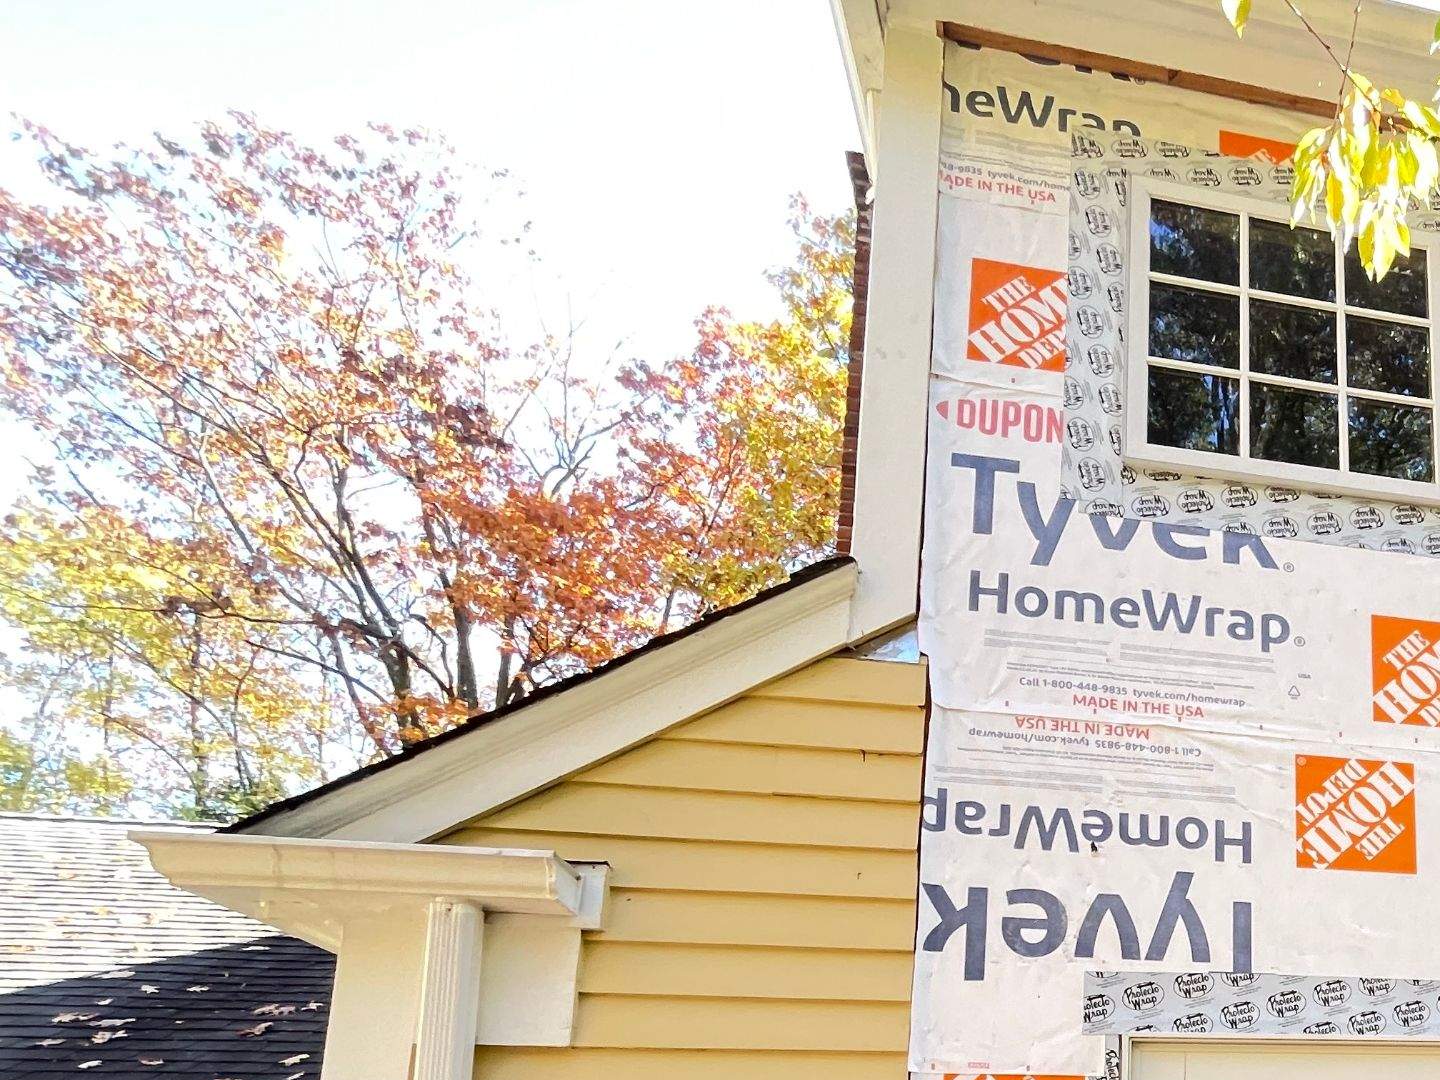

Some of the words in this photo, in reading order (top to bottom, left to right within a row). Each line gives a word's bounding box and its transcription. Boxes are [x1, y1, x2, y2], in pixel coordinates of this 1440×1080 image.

[977, 179, 993, 191] IN
[996, 182, 1024, 196] THE
[1028, 189, 1056, 202] USA
[968, 278, 1068, 363] HOM
[951, 452, 1279, 570] Tyvek
[968, 570, 1290, 652] HomeWrap
[1382, 629, 1431, 671] THE
[1019, 677, 1040, 688] Call
[1042, 679, 1128, 696] 1-800-448-9835
[1133, 687, 1246, 708] tyvek.com/homewrap
[1073, 694, 1118, 712] MADE
[1122, 700, 1139, 712] IN
[1141, 701, 1171, 715] THE
[1175, 704, 1204, 718] USA
[1015, 715, 1046, 730] USA
[1051, 718, 1079, 734] THE
[1084, 721, 1101, 735] IN
[968, 727, 1090, 748] tyvek.com/homewrap
[1104, 724, 1150, 740] MADE
[1095, 739, 1180, 755] 1-800-448-9835
[1182, 747, 1202, 757] Call
[1296, 758, 1369, 827] DEPOT
[1296, 760, 1415, 871] HOME
[922, 787, 1252, 864] HomeWrap
[1355, 816, 1406, 861] THE
[1174, 973, 1209, 990] Protecto
[1313, 980, 1347, 998] Protecto
[1123, 982, 1160, 1001] Protecto
[1182, 984, 1208, 998] Wrap
[1267, 990, 1302, 1008] Protecto
[1321, 993, 1346, 1007] Wrap
[1131, 995, 1157, 1010] Wrap
[1221, 1001, 1256, 1020] Protecto
[1275, 1003, 1300, 1018] Wrap
[1393, 1000, 1427, 1018] Protecto
[1229, 1014, 1254, 1029] Wrap
[1348, 1011, 1381, 1029] Protecto
[1356, 1022, 1380, 1036] Wrap
[1401, 1013, 1425, 1027] Wrap
